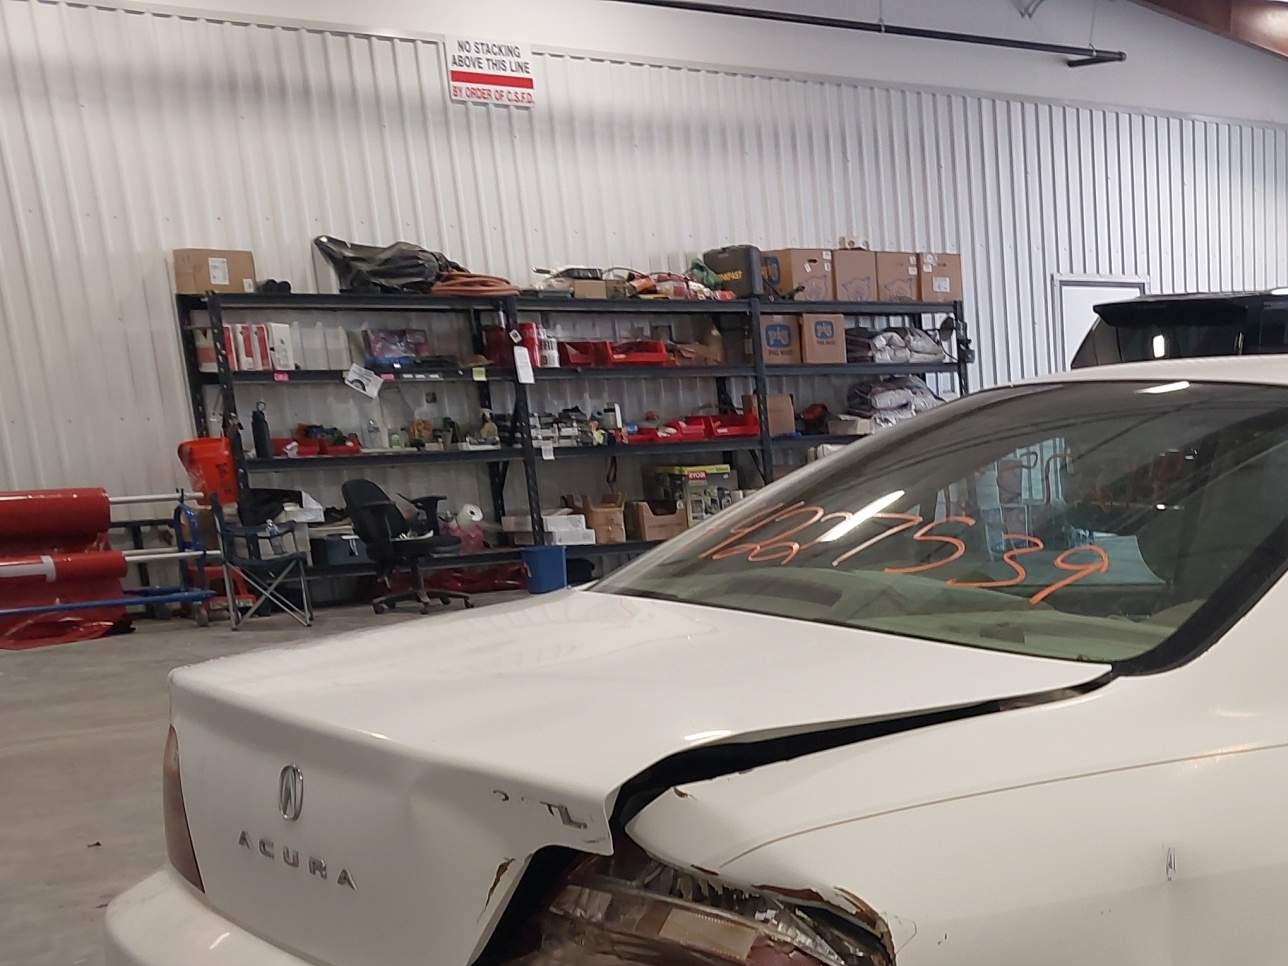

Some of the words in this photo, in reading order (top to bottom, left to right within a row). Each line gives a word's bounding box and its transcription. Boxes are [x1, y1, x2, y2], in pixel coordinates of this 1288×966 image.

[457, 40, 472, 53] NO
[474, 42, 521, 58] STACKING
[451, 55, 484, 69] ABOVE
[486, 58, 507, 72] THIS
[509, 60, 531, 74] LINE
[452, 86, 463, 98] BY
[465, 87, 492, 100] ORDER
[494, 90, 505, 101] OF
[697, 500, 1109, 604] 4227539
[238, 830, 358, 890] ACURA
